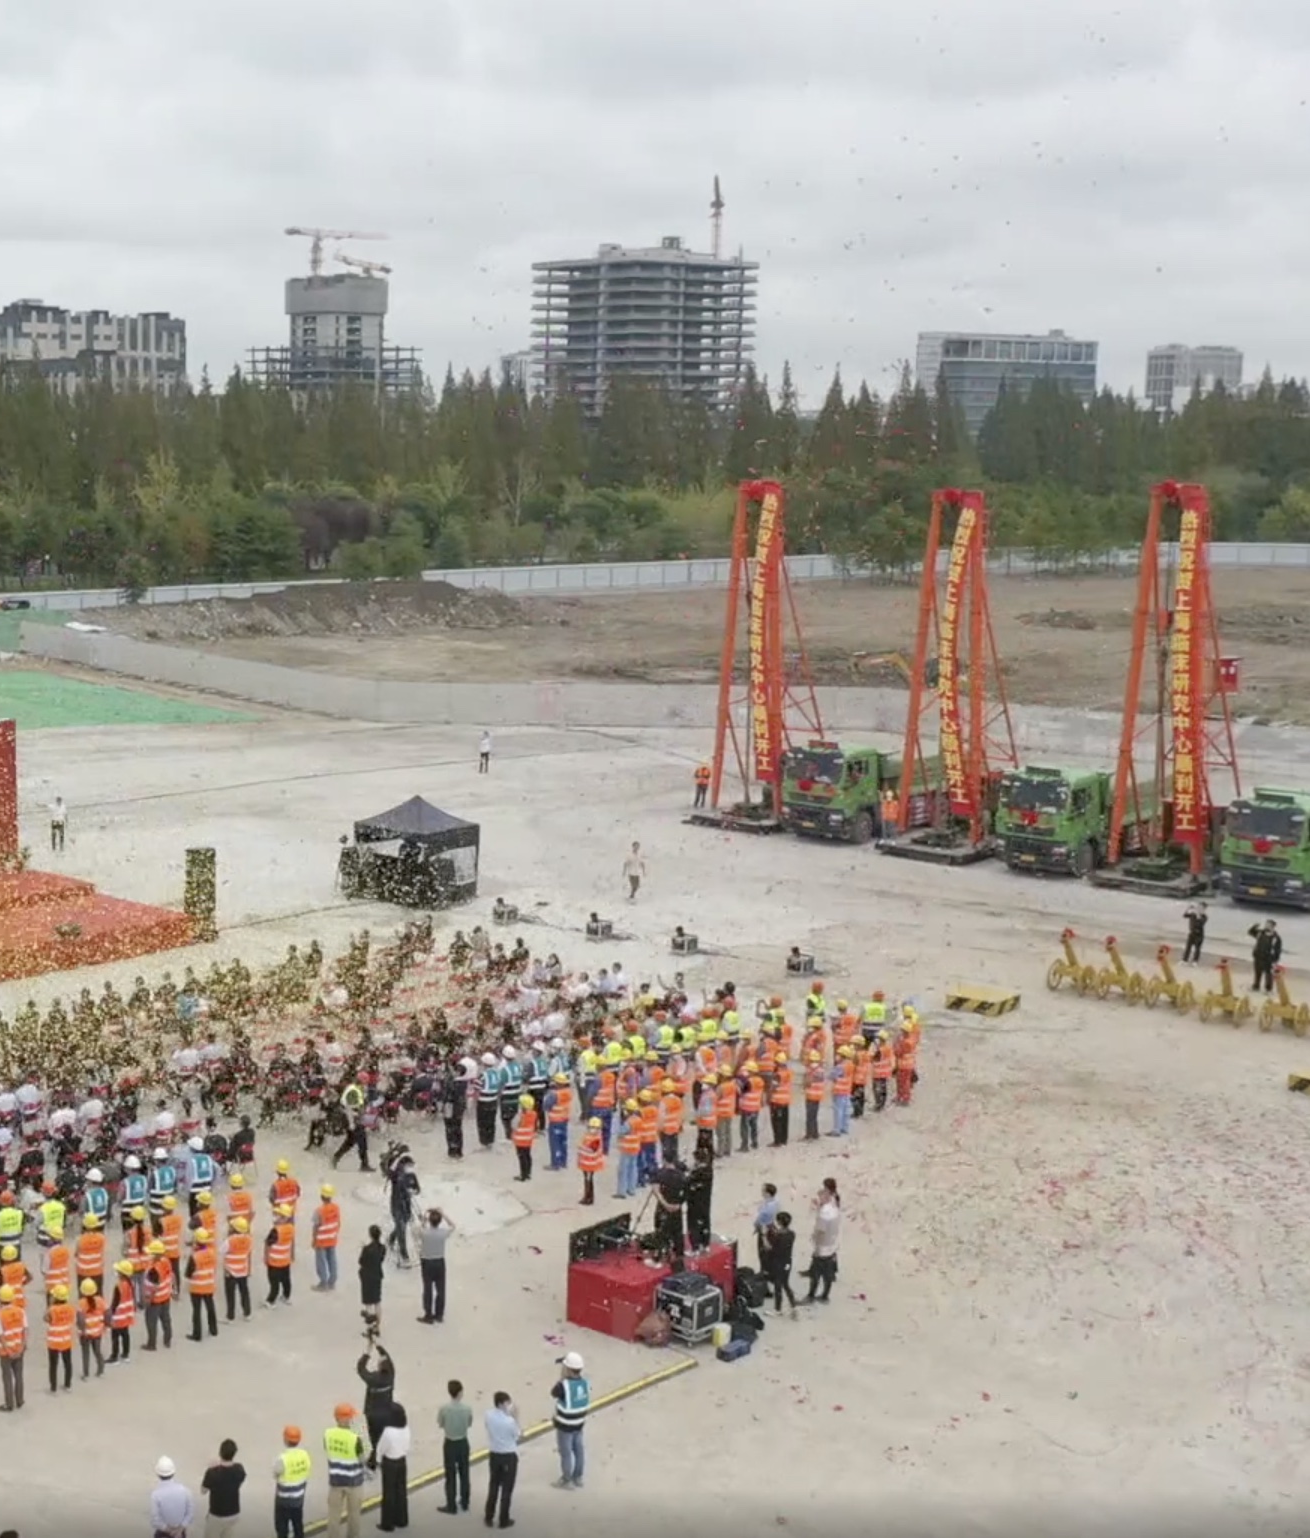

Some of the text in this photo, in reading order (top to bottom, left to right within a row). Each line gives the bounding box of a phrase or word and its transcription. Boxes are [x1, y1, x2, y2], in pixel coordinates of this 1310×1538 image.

[1171, 509, 1198, 830] 热烈祝贺上海临床研究中心顺利开工
